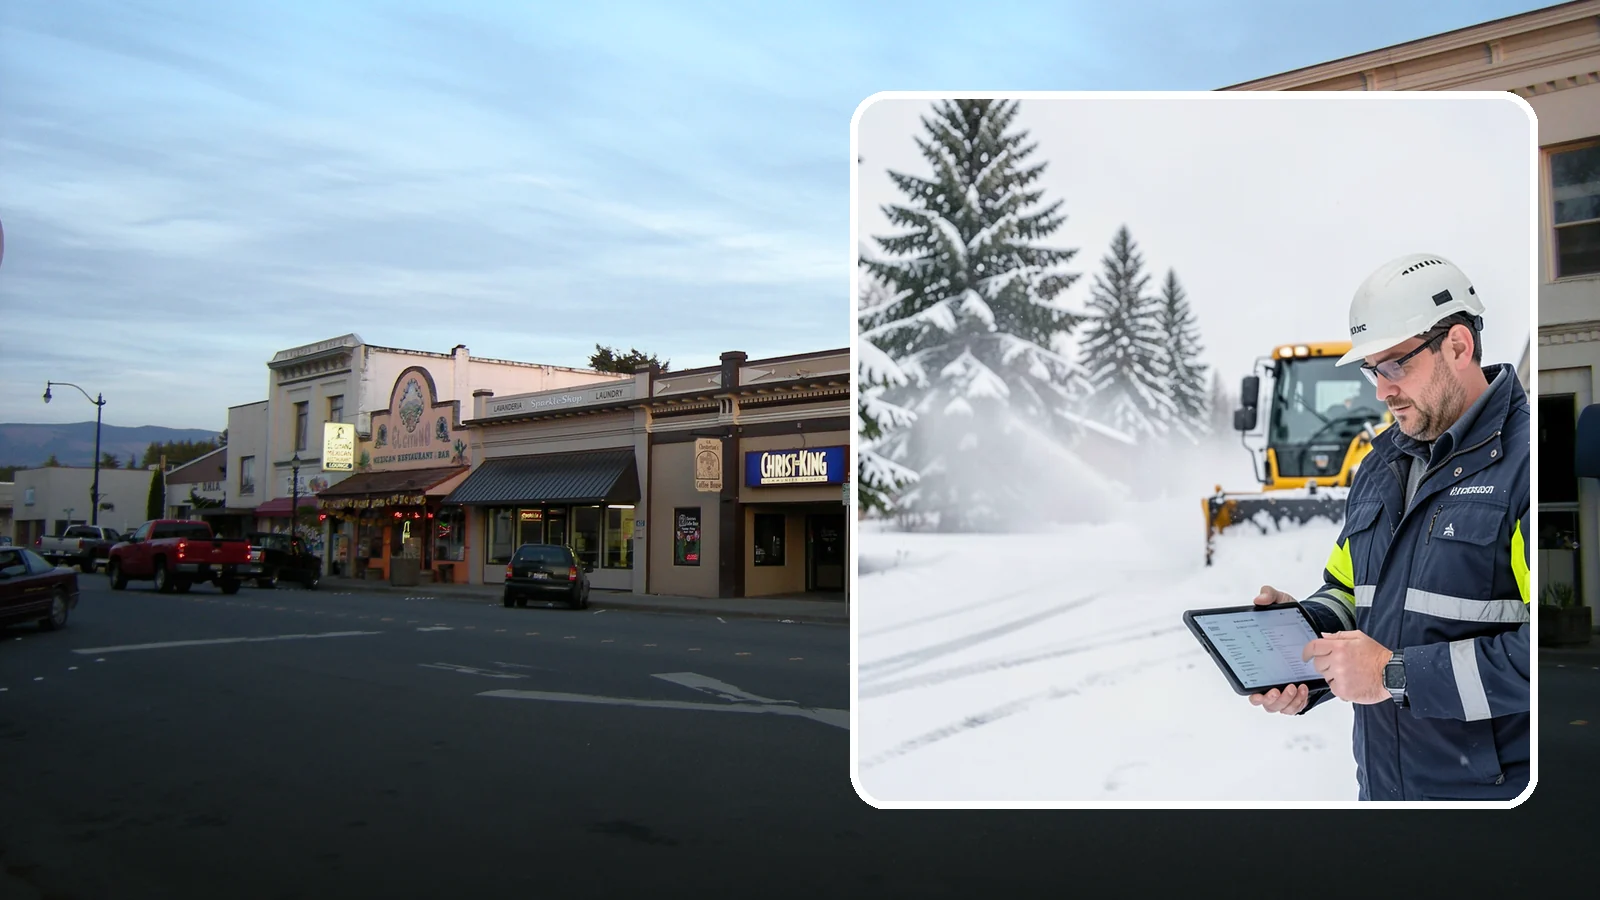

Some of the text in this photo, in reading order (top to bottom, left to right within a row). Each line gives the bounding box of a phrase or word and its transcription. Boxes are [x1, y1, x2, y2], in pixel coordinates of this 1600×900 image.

[494, 402, 523, 412] LAVANDERIA
[562, 394, 583, 405] Shop
[595, 389, 623, 400] LAUNDRY
[373, 454, 396, 464] MEXICAN
[397, 452, 433, 462] RESTAURANT
[438, 450, 450, 459] BAR
[761, 450, 827, 477] CHRIST KING
